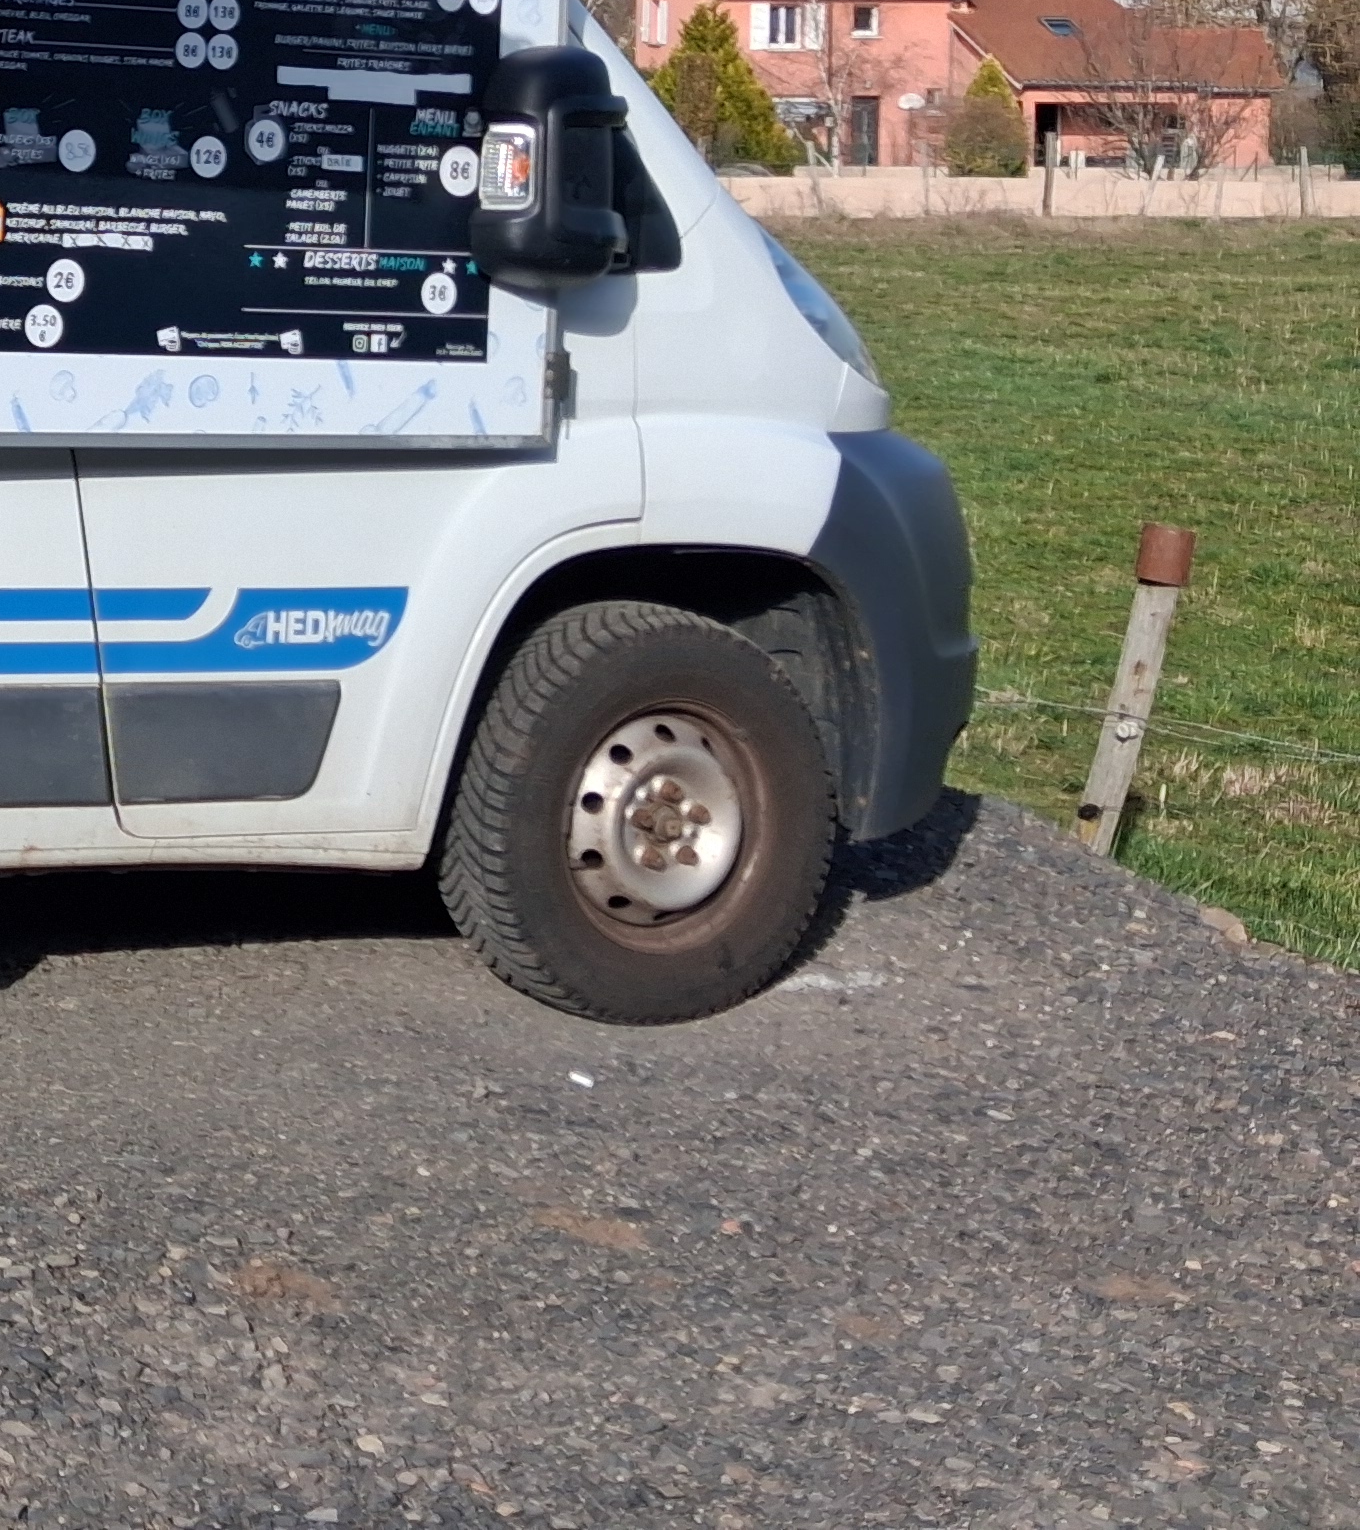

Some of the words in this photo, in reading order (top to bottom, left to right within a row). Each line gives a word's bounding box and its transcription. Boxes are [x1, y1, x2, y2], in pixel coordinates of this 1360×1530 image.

[268, 101, 329, 119] SNACKS
[415, 108, 457, 124] MENU
[410, 123, 460, 136] ENFANT
[255, 131, 275, 148] 4€
[195, 149, 222, 165] 12€
[449, 160, 470, 181] 8€
[303, 252, 378, 271] DESSERTS
[379, 257, 426, 270] MAISON
[53, 272, 75, 289] 2€
[428, 286, 447, 301] 3€
[29, 314, 57, 327] 3.50
